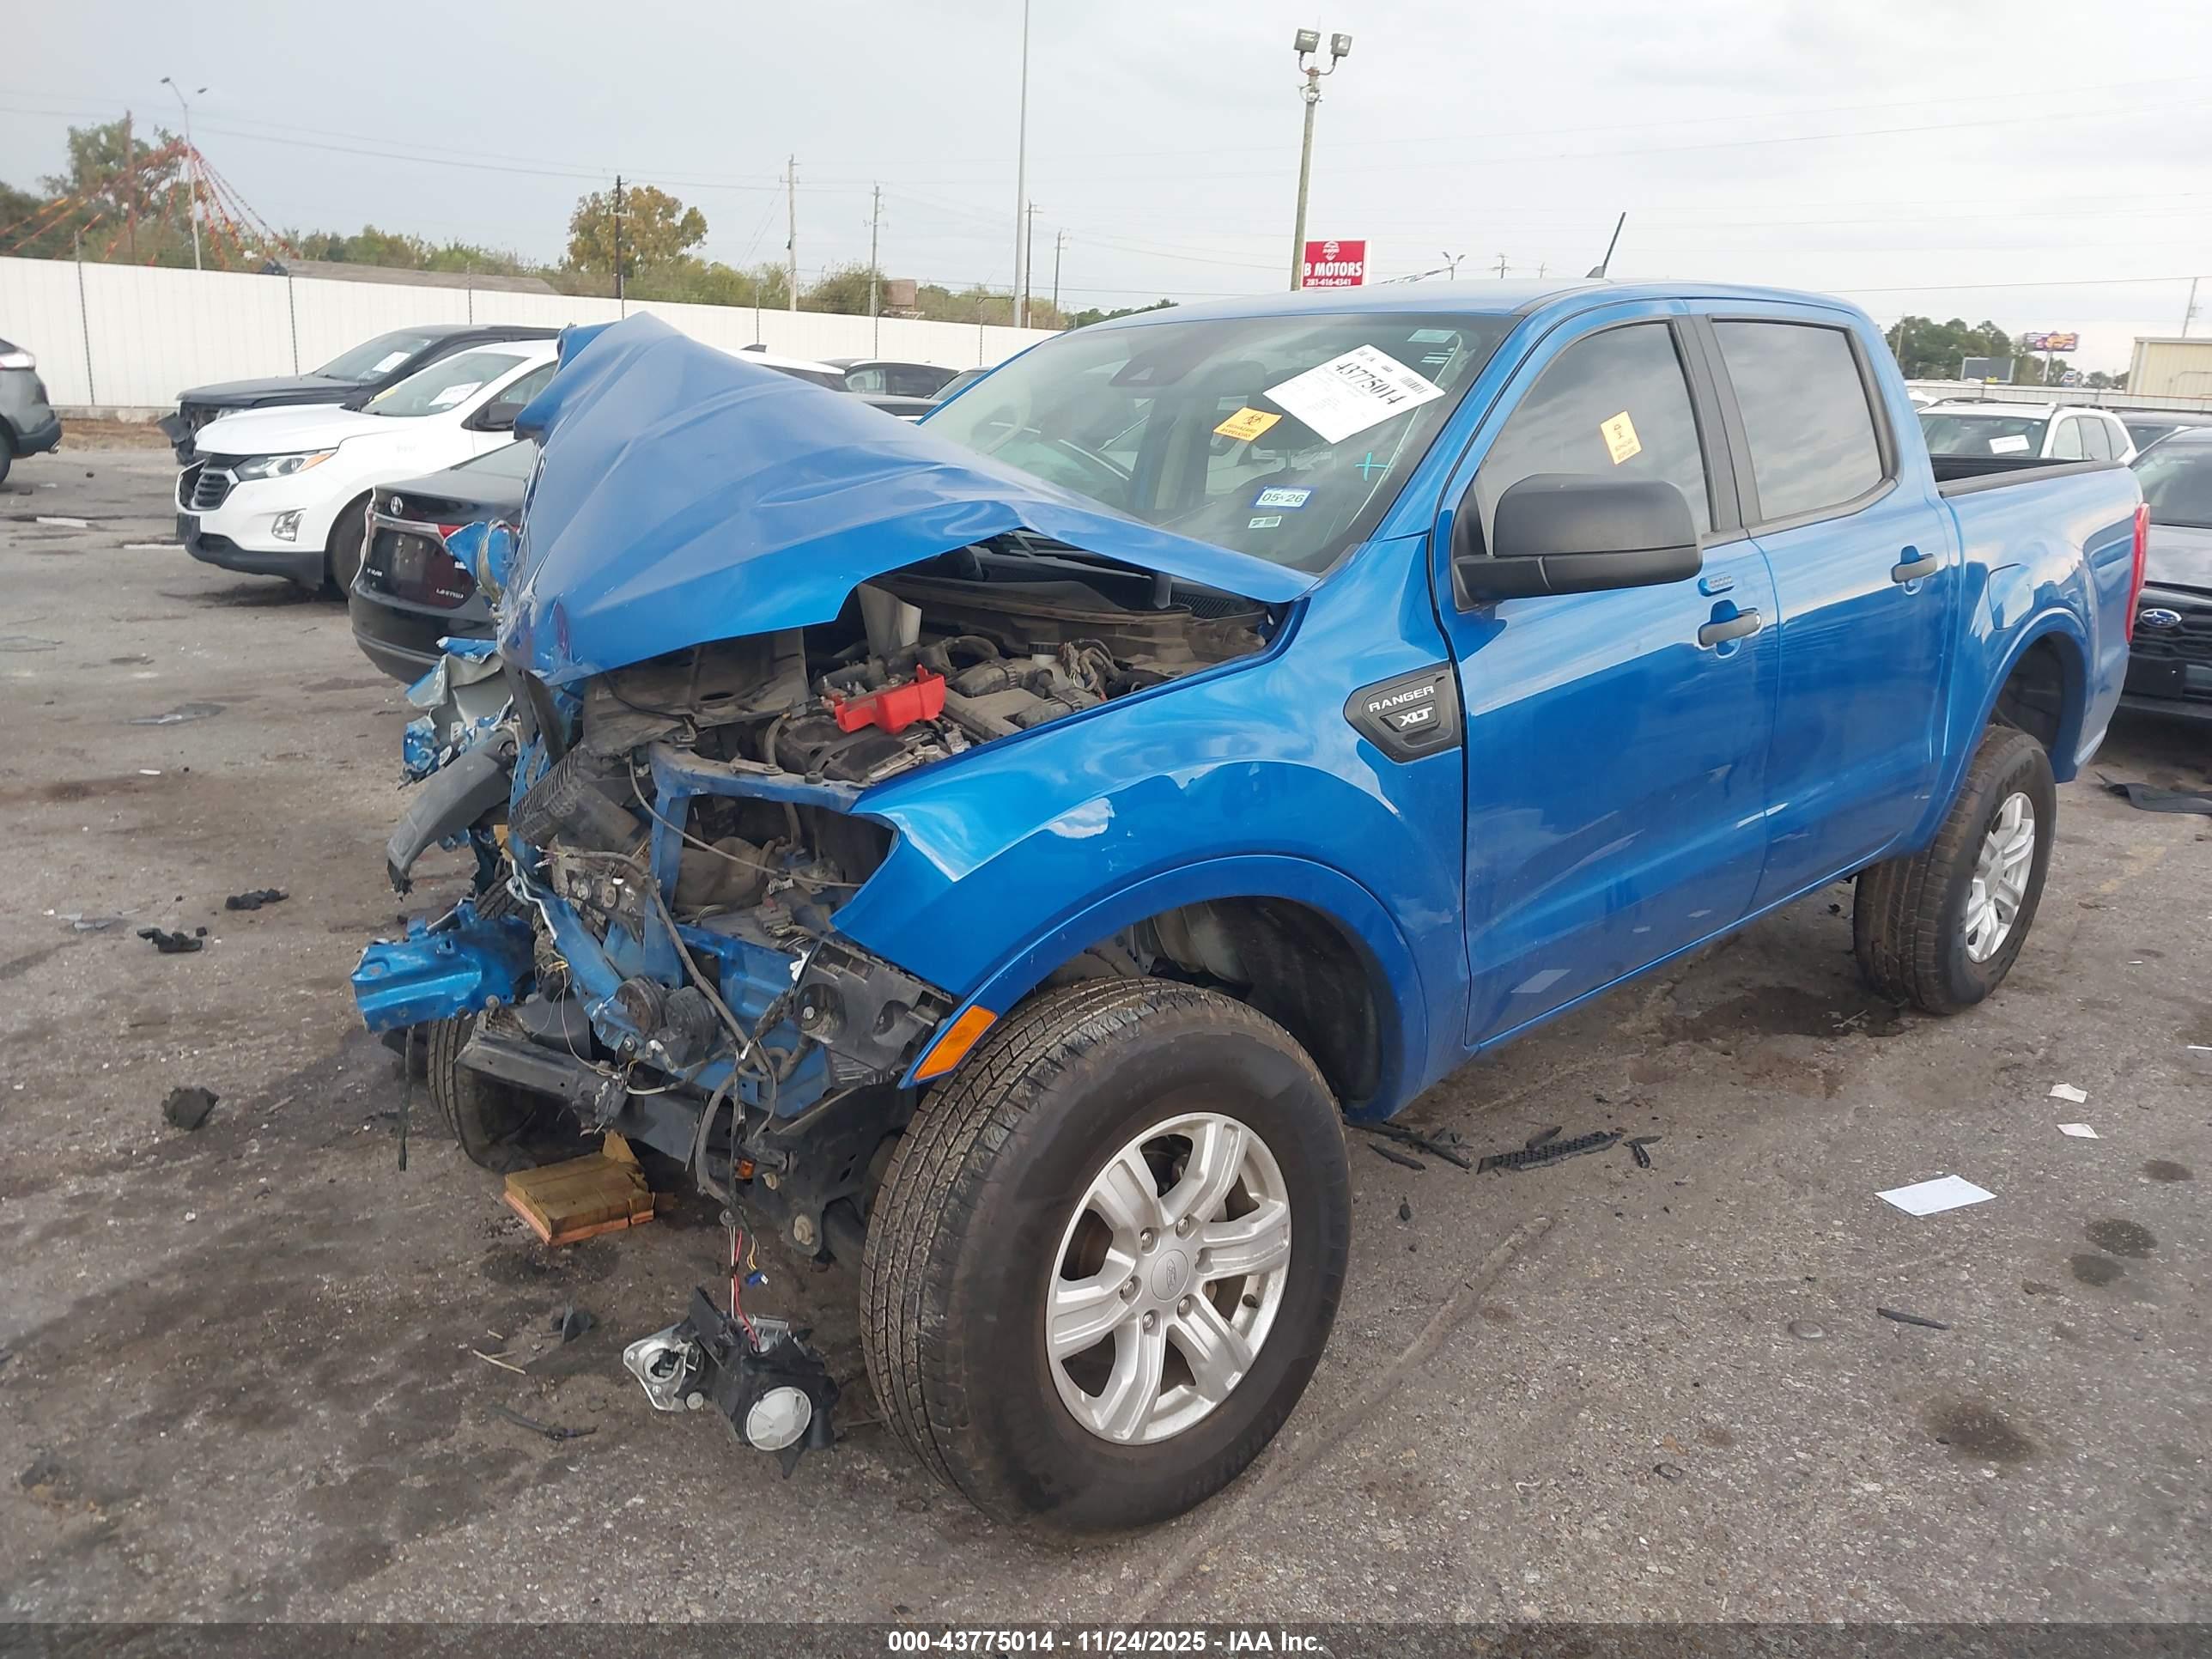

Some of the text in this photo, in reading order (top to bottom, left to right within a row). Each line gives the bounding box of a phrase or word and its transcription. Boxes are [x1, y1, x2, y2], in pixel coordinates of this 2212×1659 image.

[1315, 261, 1363, 276] MOTORS
[1335, 362, 1407, 405] 43775014
[1368, 685, 1435, 713] RANGER
[1400, 706, 1433, 727] XLT
